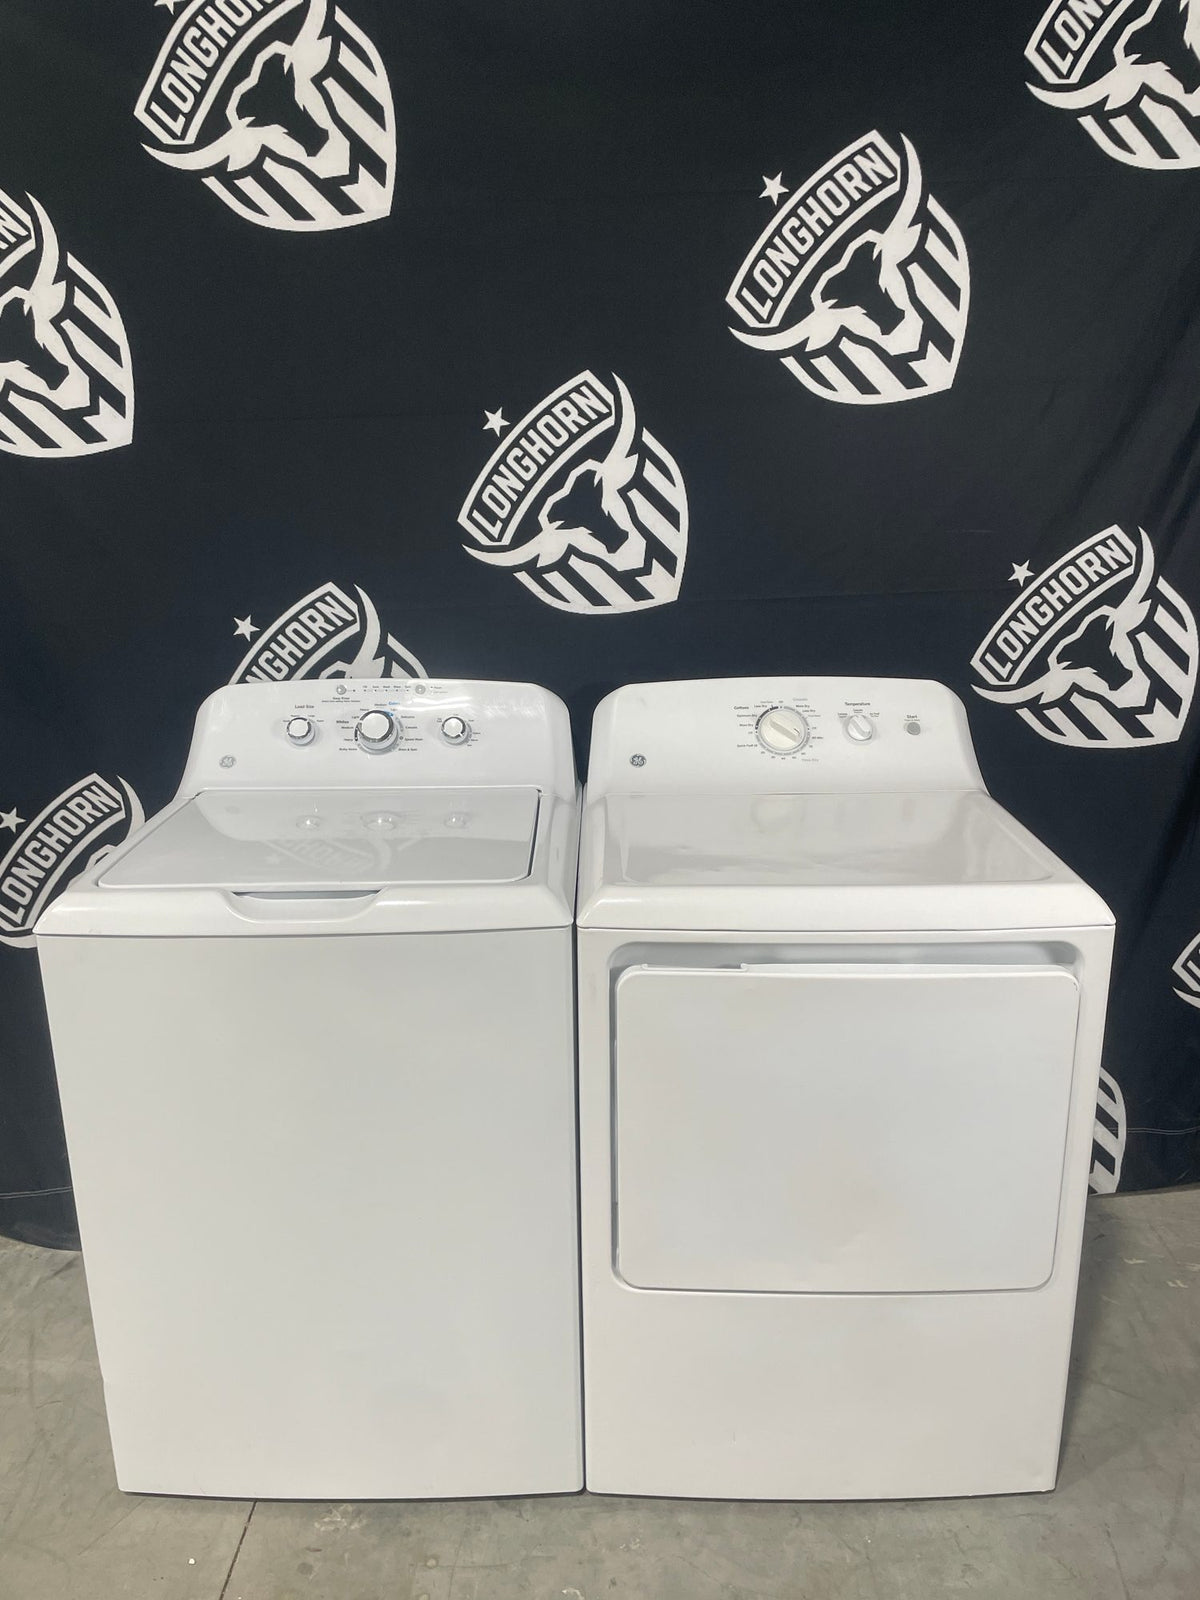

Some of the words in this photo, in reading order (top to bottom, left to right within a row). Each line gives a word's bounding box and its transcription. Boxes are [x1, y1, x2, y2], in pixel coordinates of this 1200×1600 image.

[150, 0, 275, 137] LONGHO
[741, 147, 895, 320] LONGHORN
[472, 385, 610, 539] LONGHORN
[984, 538, 1131, 679] LONGHORN
[0, 785, 120, 925] LONGHORN
